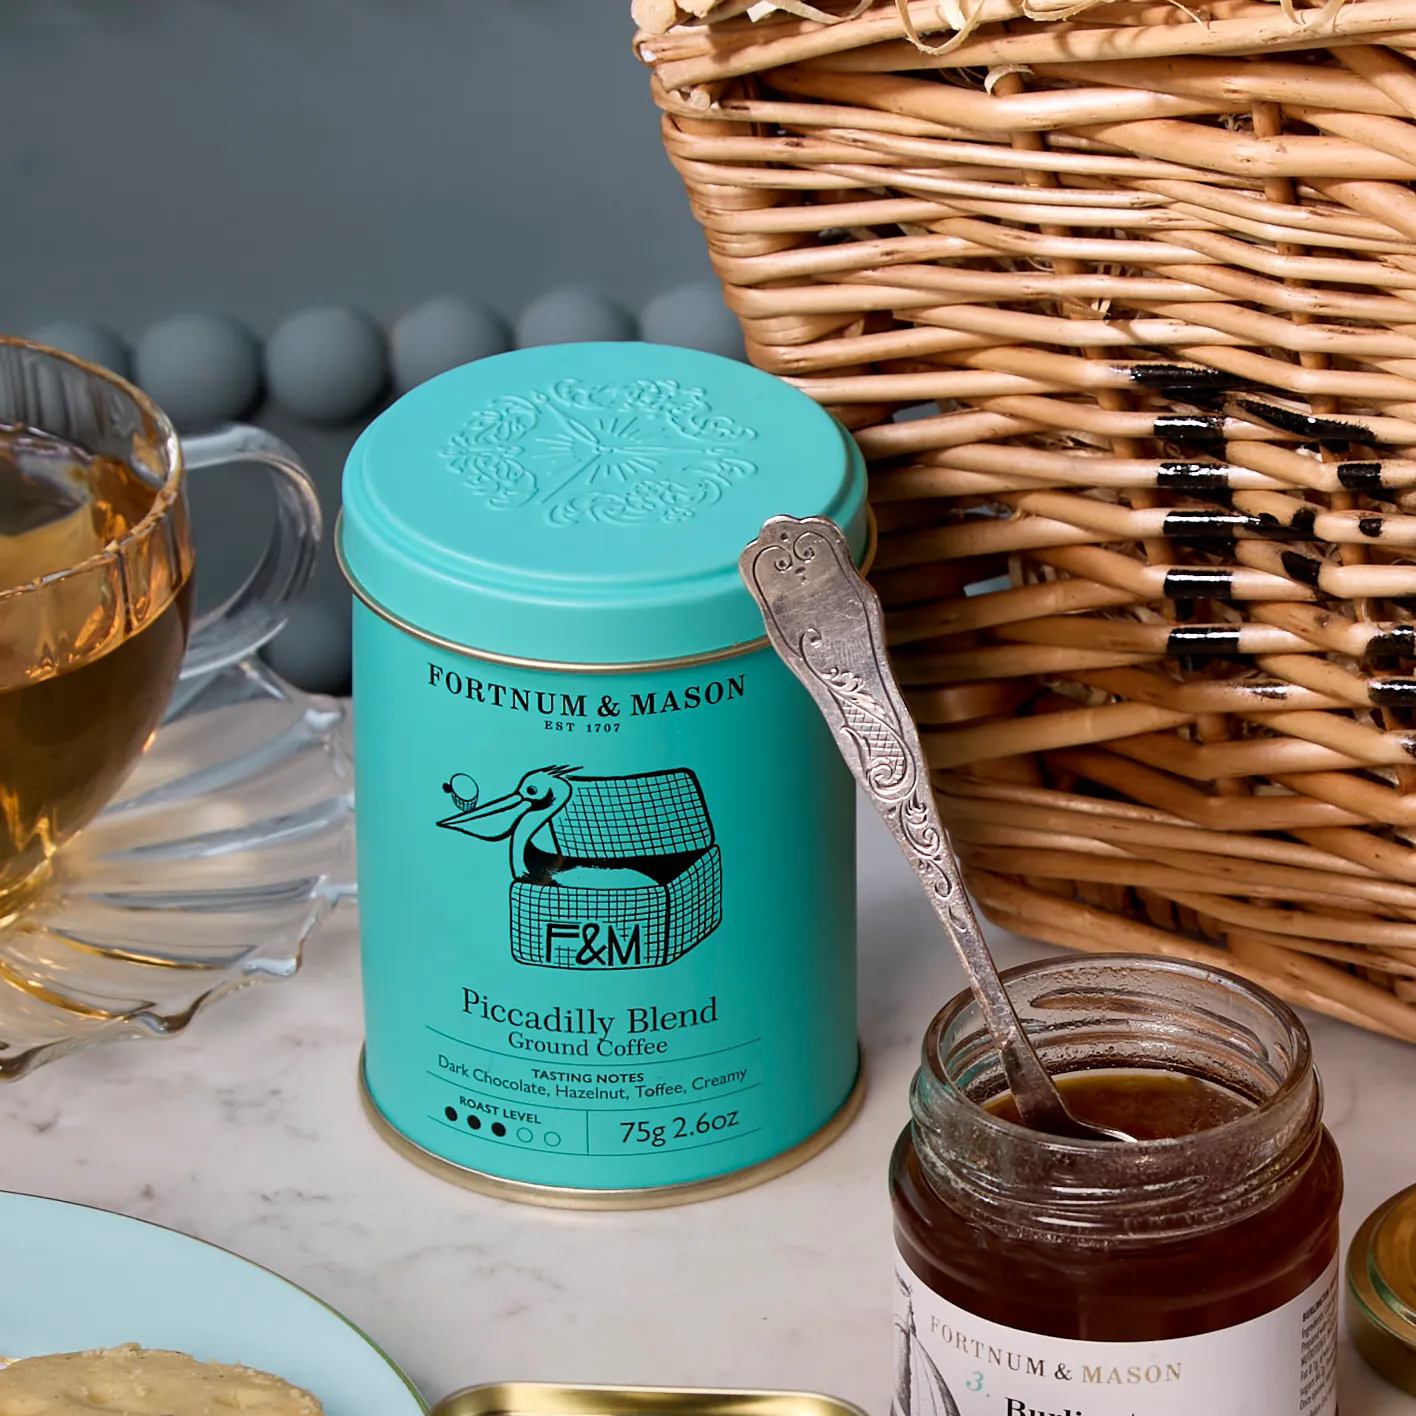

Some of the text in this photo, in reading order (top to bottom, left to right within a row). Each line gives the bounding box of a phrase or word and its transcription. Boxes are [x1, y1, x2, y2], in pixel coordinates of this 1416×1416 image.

[427, 662, 746, 717] FORTNUM & MASON
[544, 720, 621, 733] EST 1707
[545, 922, 640, 966] F&M
[462, 987, 718, 1040] Piccadilly Blend
[508, 1031, 668, 1057] Ground Coffee
[438, 1055, 748, 1101] Dark Chocolate, Hazelnut, Toffee, Creamy
[531, 1069, 644, 1084] TASTING NOTES
[459, 1095, 541, 1124] ROAST LEVEL
[619, 1110, 739, 1147] 75g 2.6oz
[930, 1314, 1182, 1385] FORTNUM & MASON
